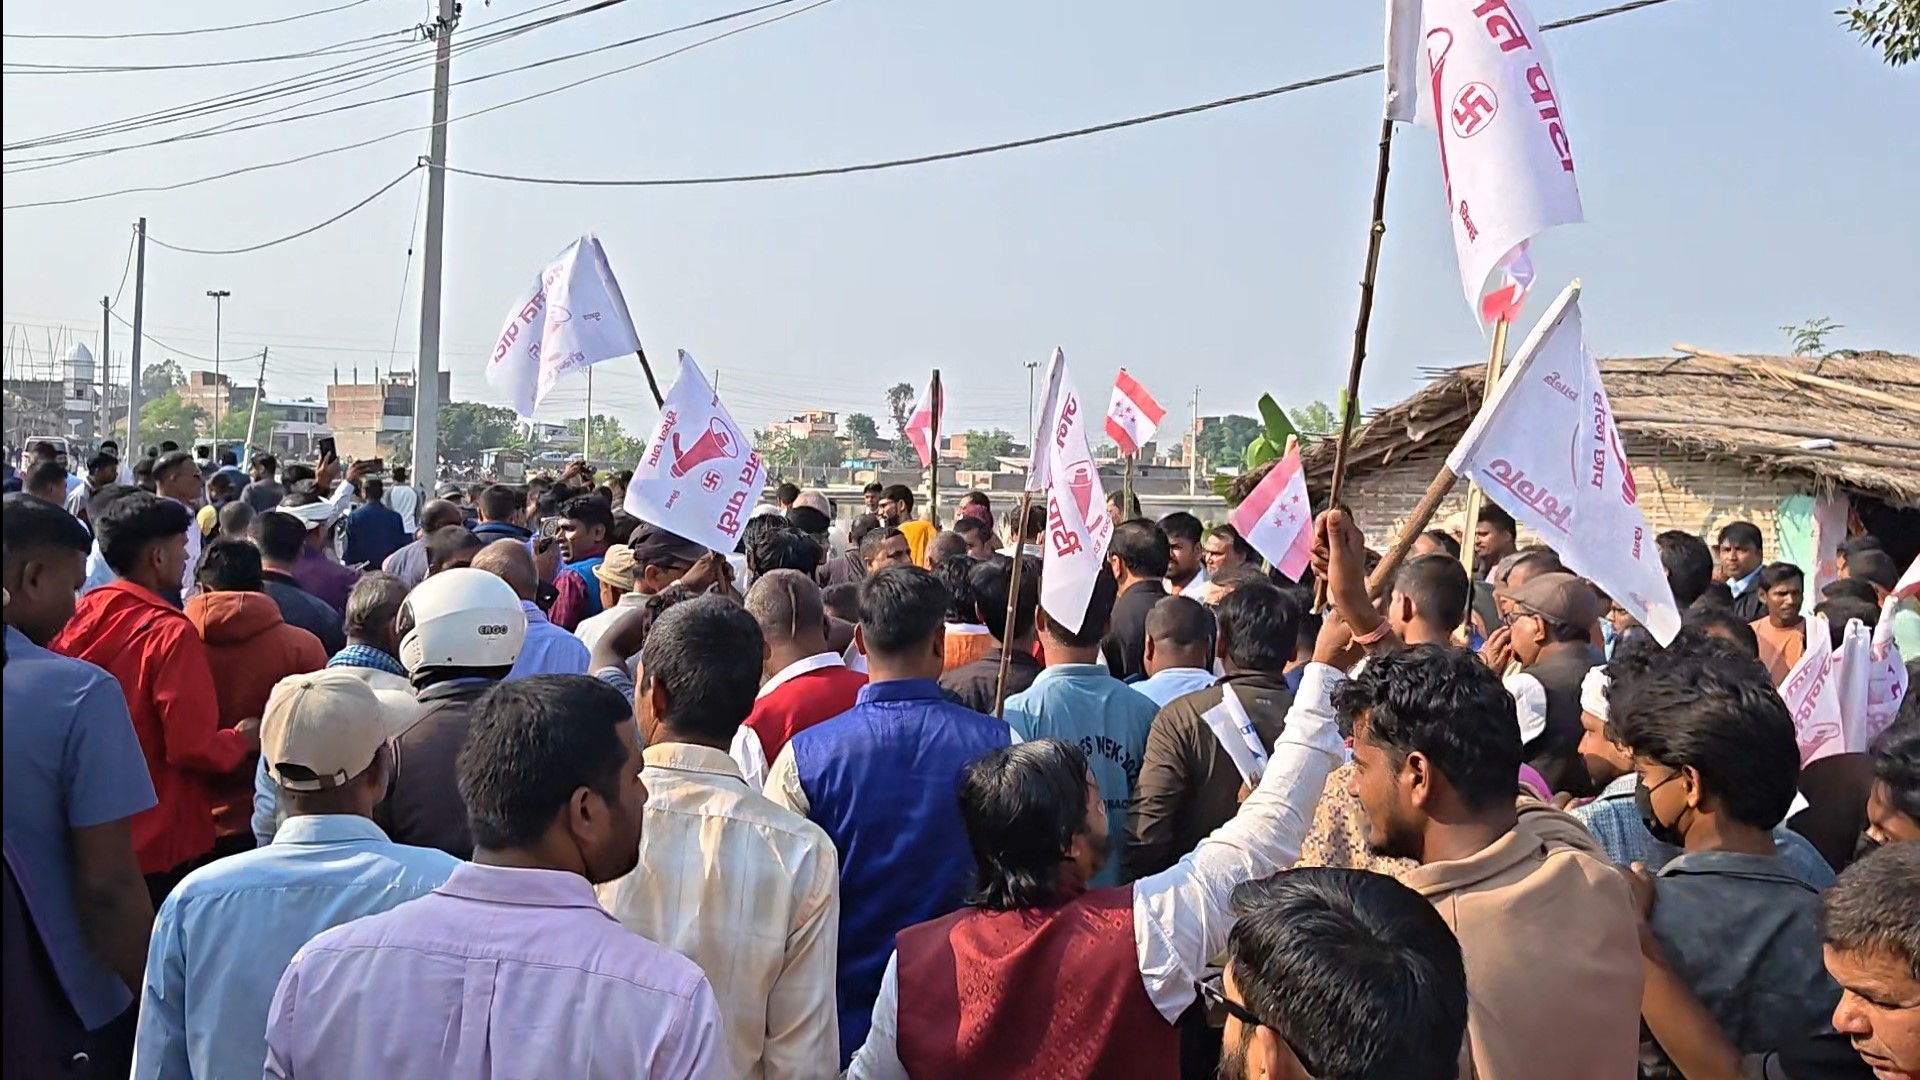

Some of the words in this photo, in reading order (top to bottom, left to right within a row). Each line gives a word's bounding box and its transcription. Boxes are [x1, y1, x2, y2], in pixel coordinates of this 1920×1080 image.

[647, 442, 664, 469] छाप
[1590, 447, 1606, 491] छाप
[716, 490, 749, 539] पार्टी
